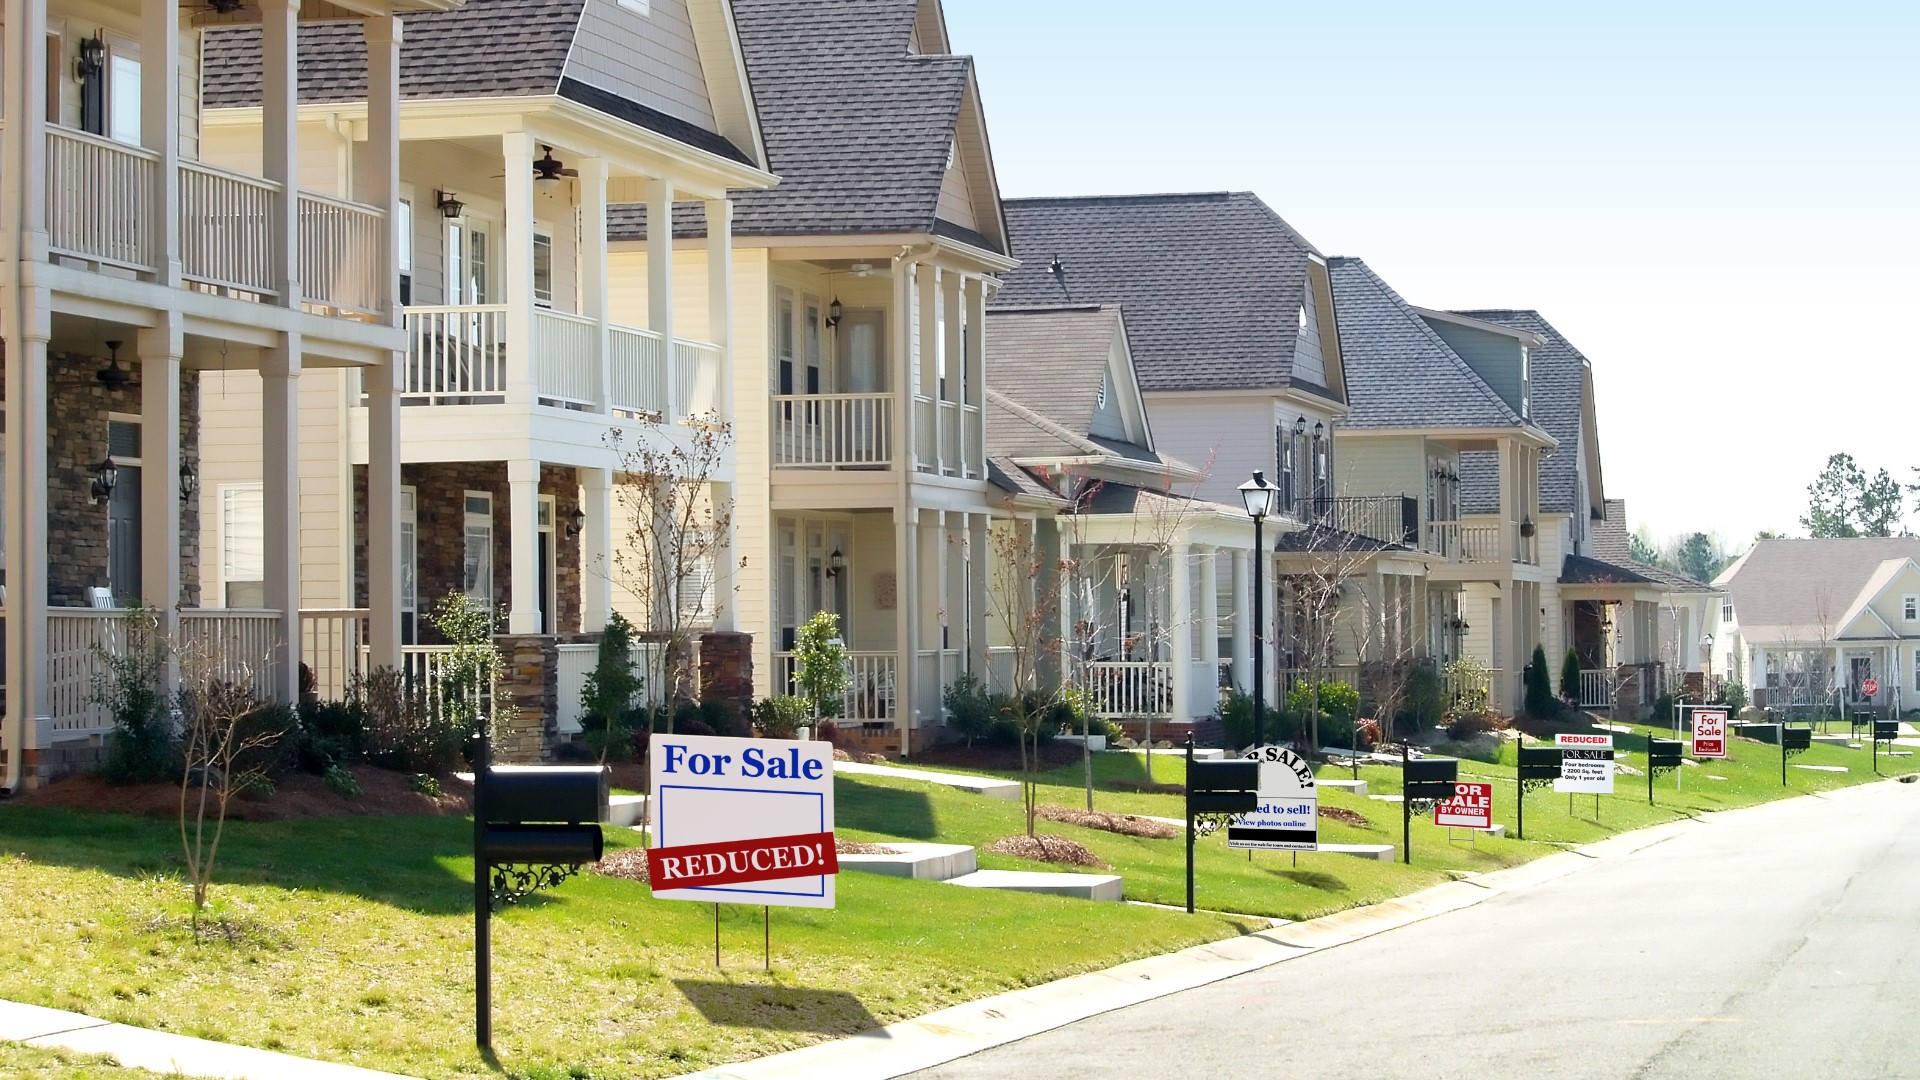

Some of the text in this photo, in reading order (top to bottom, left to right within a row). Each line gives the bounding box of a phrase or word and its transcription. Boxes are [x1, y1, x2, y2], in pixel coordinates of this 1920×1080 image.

[1702, 714, 1718, 724] For
[1698, 726, 1722, 736] Sale
[1562, 750, 1606, 759] FOR SALE
[662, 744, 824, 780] For Sale
[1266, 747, 1314, 788] SALE!
[1456, 784, 1482, 795] OR
[1273, 805, 1284, 814] to
[1287, 804, 1310, 814] sell!
[1455, 807, 1484, 816] OWNER
[660, 842, 825, 880] REDUCED!
